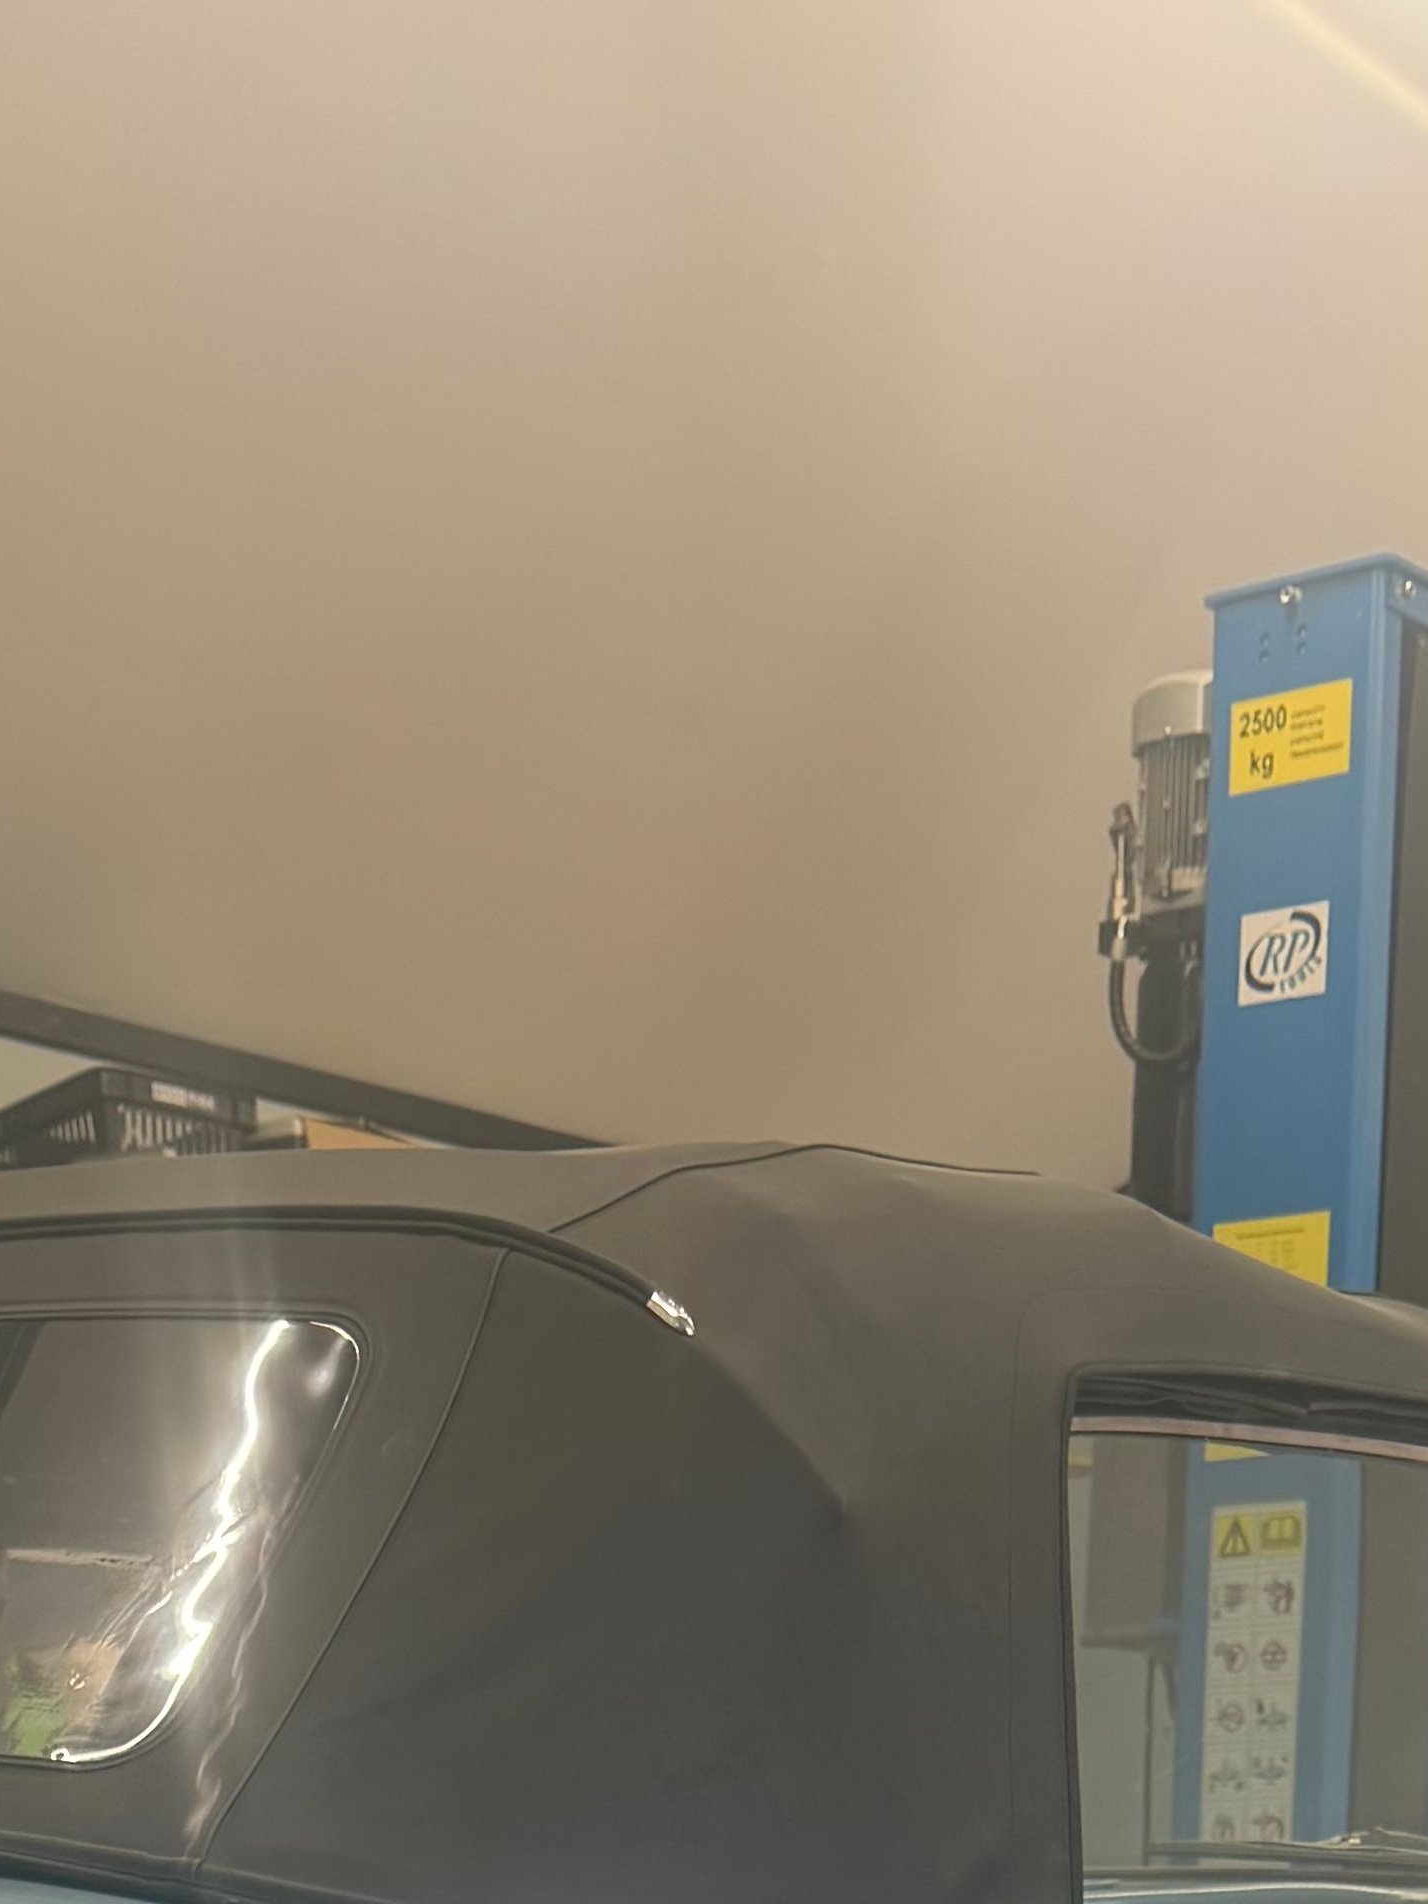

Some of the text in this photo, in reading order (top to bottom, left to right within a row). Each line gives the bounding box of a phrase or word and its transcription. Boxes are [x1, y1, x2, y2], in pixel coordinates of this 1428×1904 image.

[1239, 703, 1288, 740] 2500
[1249, 748, 1274, 781] kg
[1259, 929, 1311, 977] RP
